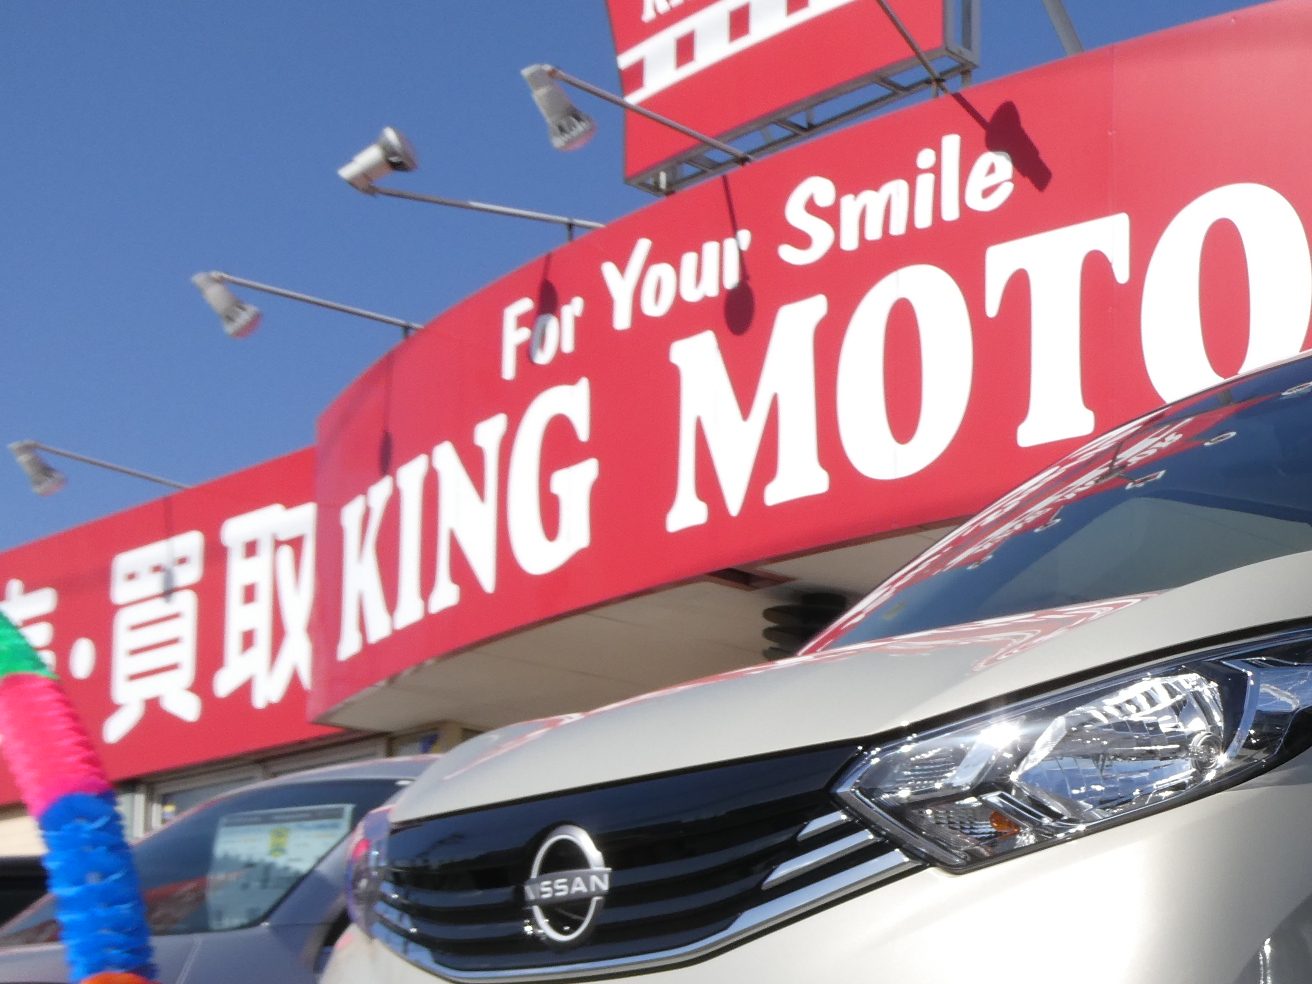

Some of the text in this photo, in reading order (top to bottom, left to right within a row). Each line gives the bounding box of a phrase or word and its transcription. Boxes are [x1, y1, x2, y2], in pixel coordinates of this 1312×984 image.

[501, 134, 1014, 380] For Your Smile
[337, 377, 598, 661] KING
[524, 873, 610, 900] SSAN
